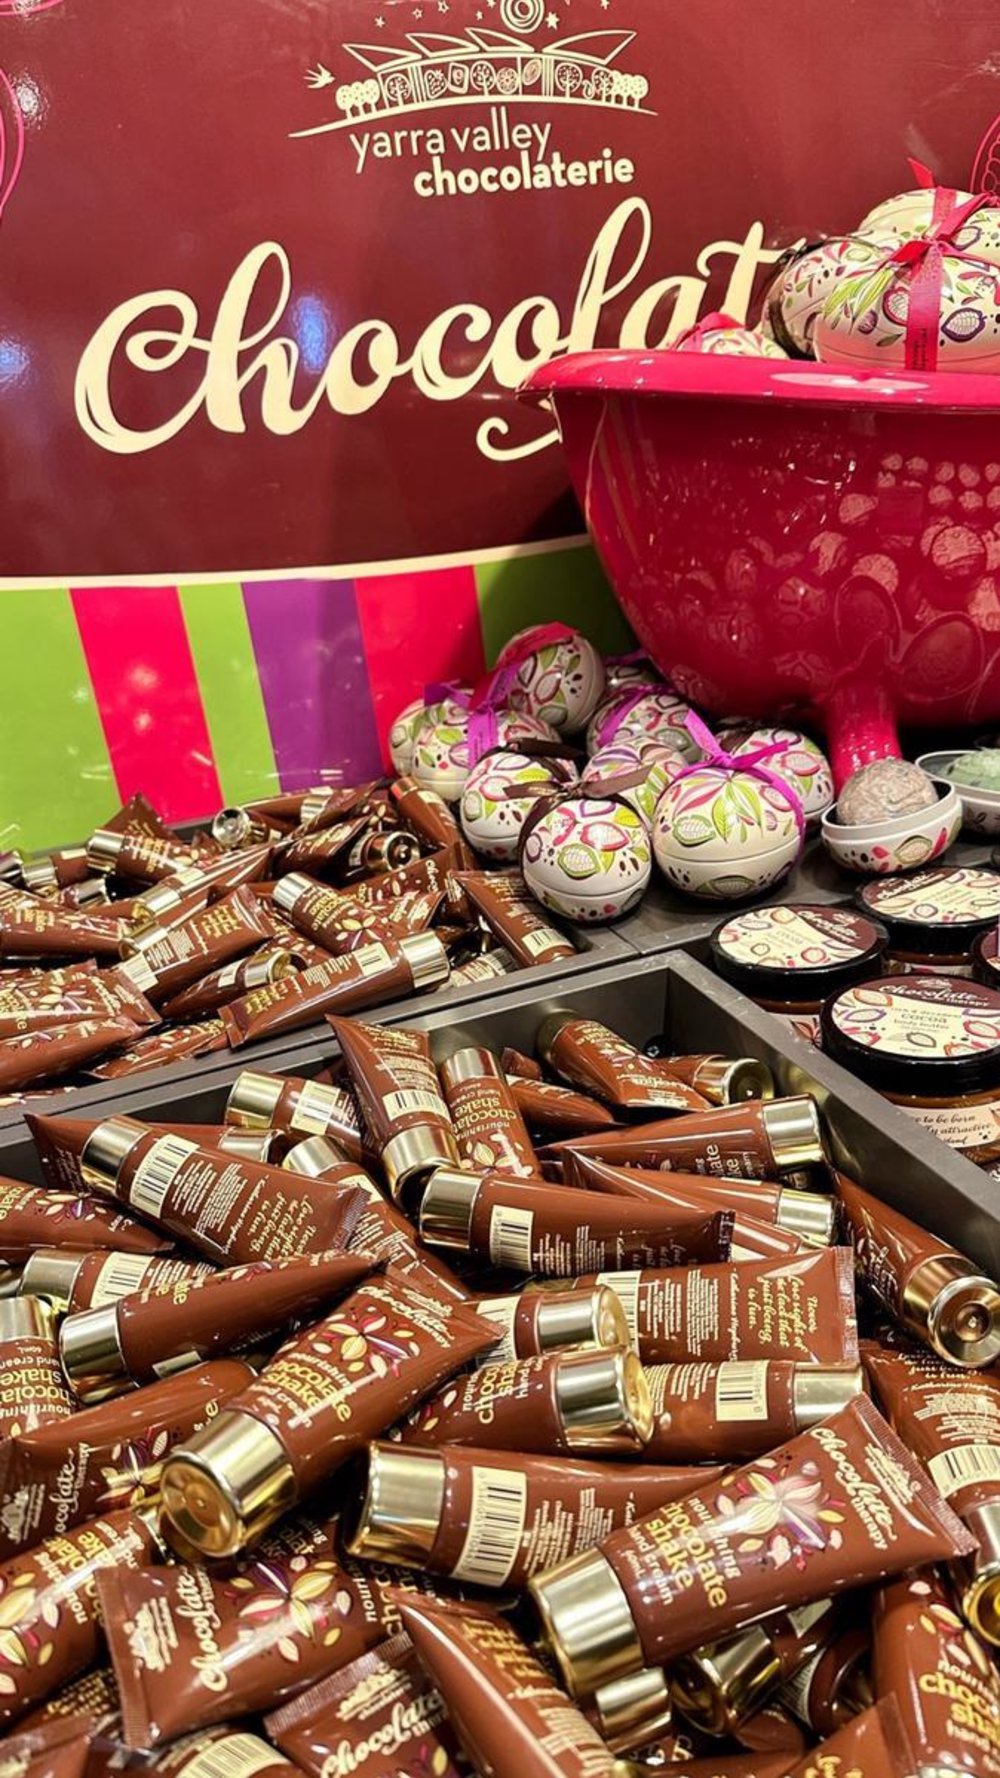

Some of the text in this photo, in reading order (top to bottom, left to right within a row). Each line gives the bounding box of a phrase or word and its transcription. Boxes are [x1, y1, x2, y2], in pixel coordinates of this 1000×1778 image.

[349, 107, 553, 173] yarra valley
[413, 148, 635, 197] chocolaterie
[74, 197, 806, 460] Chocolat
[901, 1013, 948, 1024] cocoa
[452, 1109, 517, 1133] chocolat
[454, 1098, 501, 1117] shake
[358, 1286, 455, 1341] Chocolate
[0, 1369, 62, 1386] shake
[264, 1372, 322, 1411] shake
[49, 1448, 78, 1534] ocolate
[809, 1427, 898, 1541] Chocolate
[851, 1497, 888, 1550] therapy
[646, 1517, 695, 1592] shake
[176, 1566, 230, 1692] Chocolate
